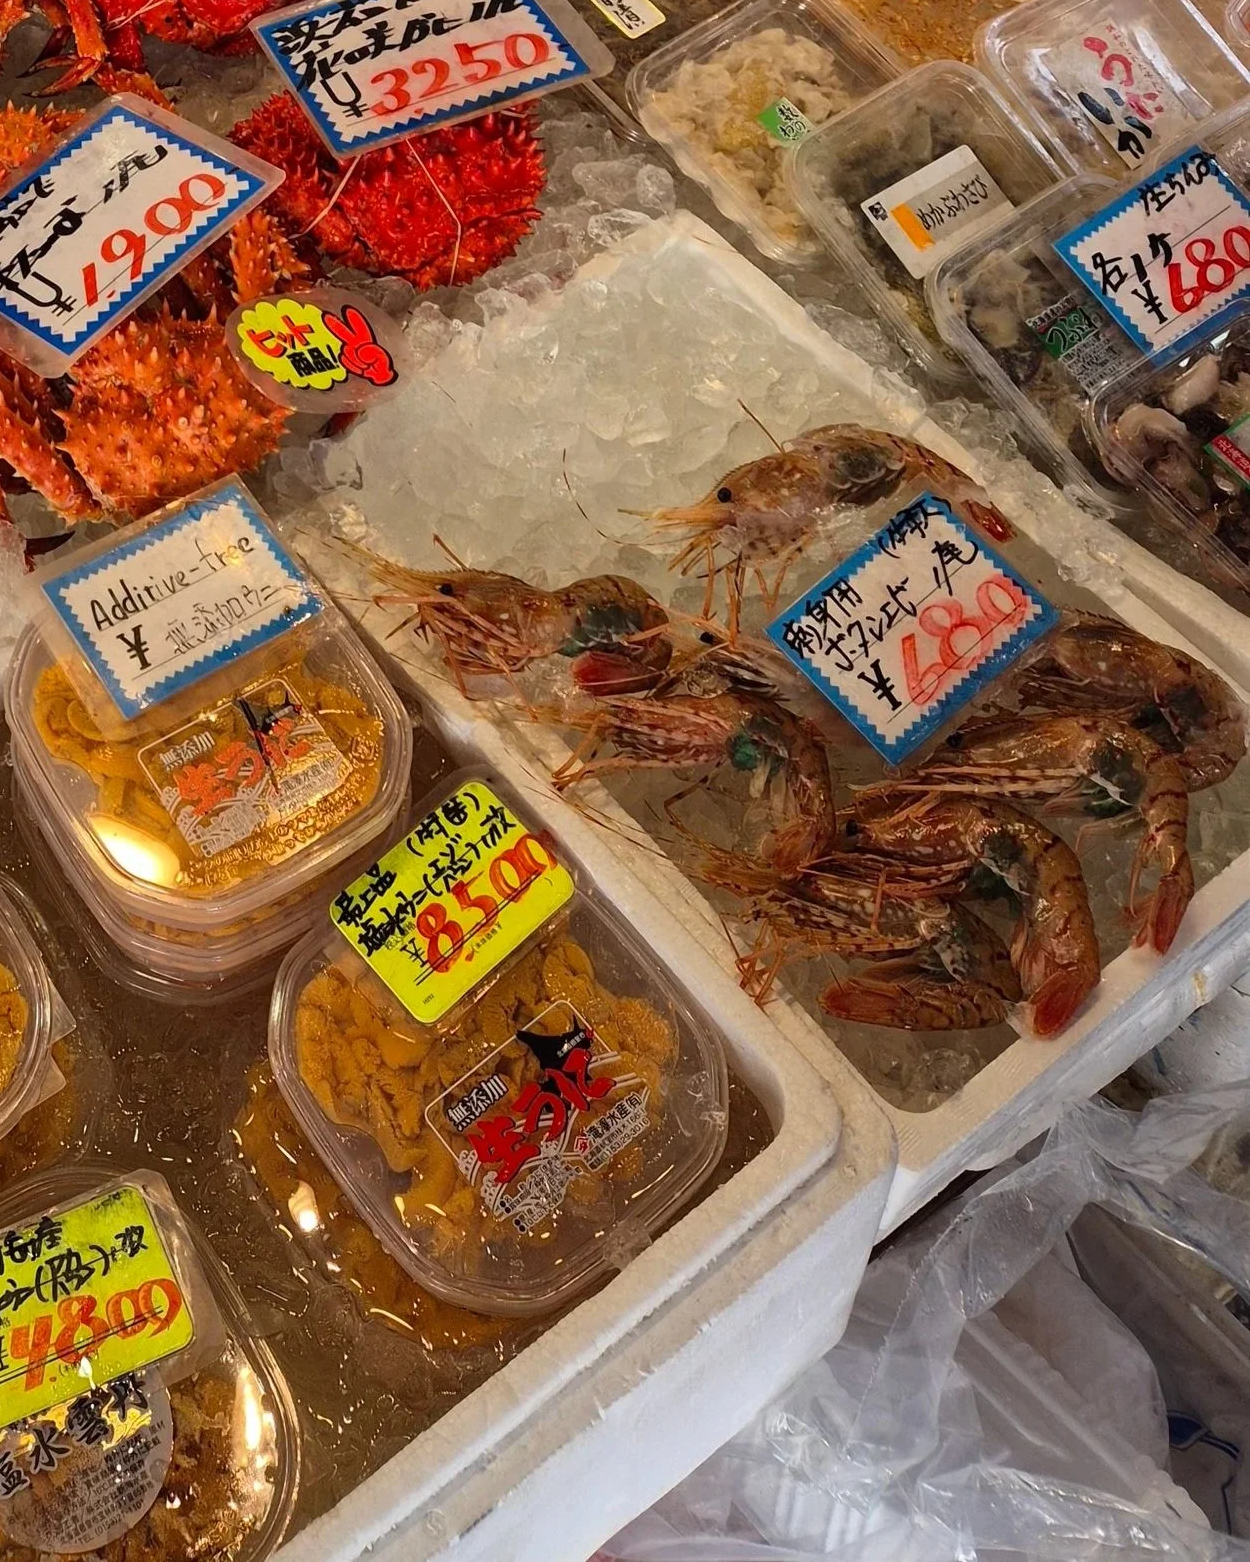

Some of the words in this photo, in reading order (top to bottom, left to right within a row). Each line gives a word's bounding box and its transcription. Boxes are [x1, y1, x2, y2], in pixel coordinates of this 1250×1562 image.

[318, 30, 550, 119] ¥3250
[10, 170, 227, 318] ¥1900
[916, 172, 992, 234] めかぶわさび
[243, 314, 316, 360] ヒット
[857, 576, 1031, 712] ¥680
[401, 828, 560, 974] ¥8500
[446, 1074, 509, 1132] 無添加
[466, 1047, 616, 1186] 生うに
